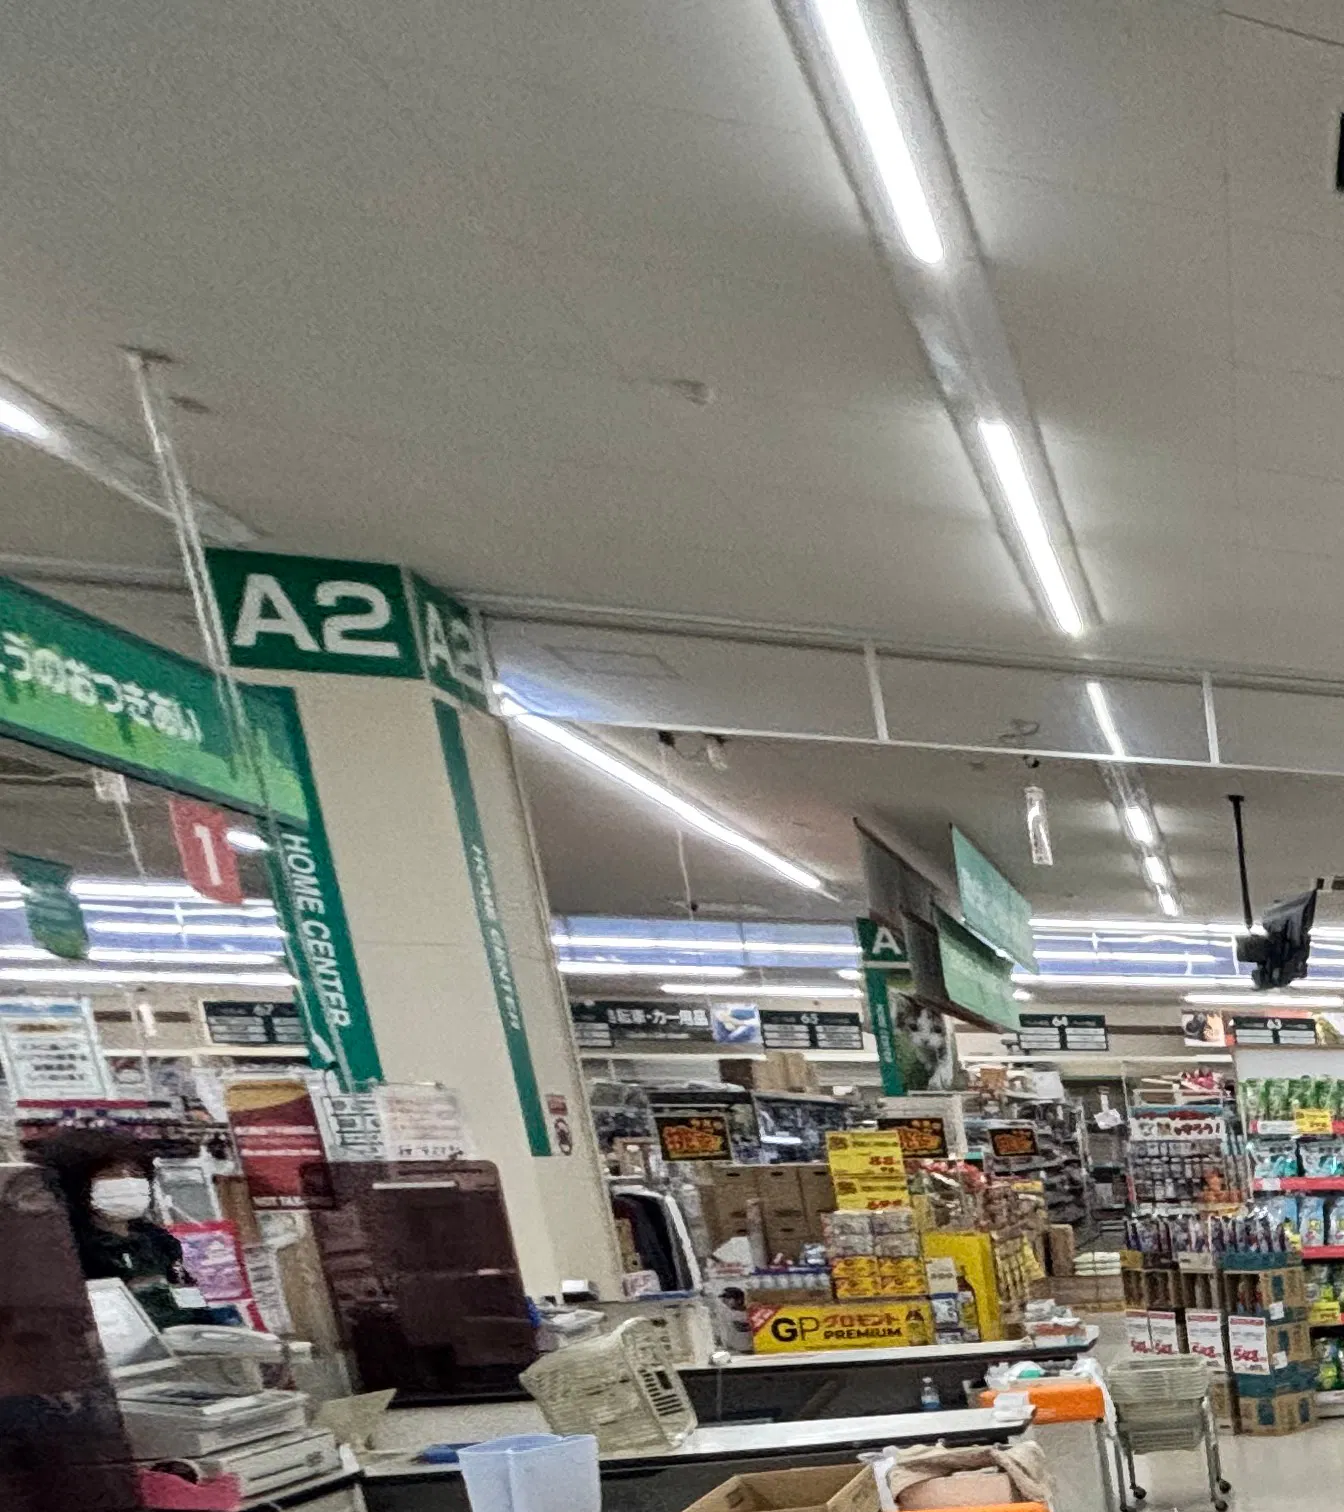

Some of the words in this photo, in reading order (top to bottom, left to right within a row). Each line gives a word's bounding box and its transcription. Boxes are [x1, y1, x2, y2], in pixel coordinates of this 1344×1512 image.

[233, 574, 399, 659] A2
[196, 825, 222, 886] 1
[281, 832, 325, 915] HOME
[302, 920, 351, 1027] CENTER
[771, 1317, 820, 1341] GP
[823, 1327, 902, 1340] PREMIUM
